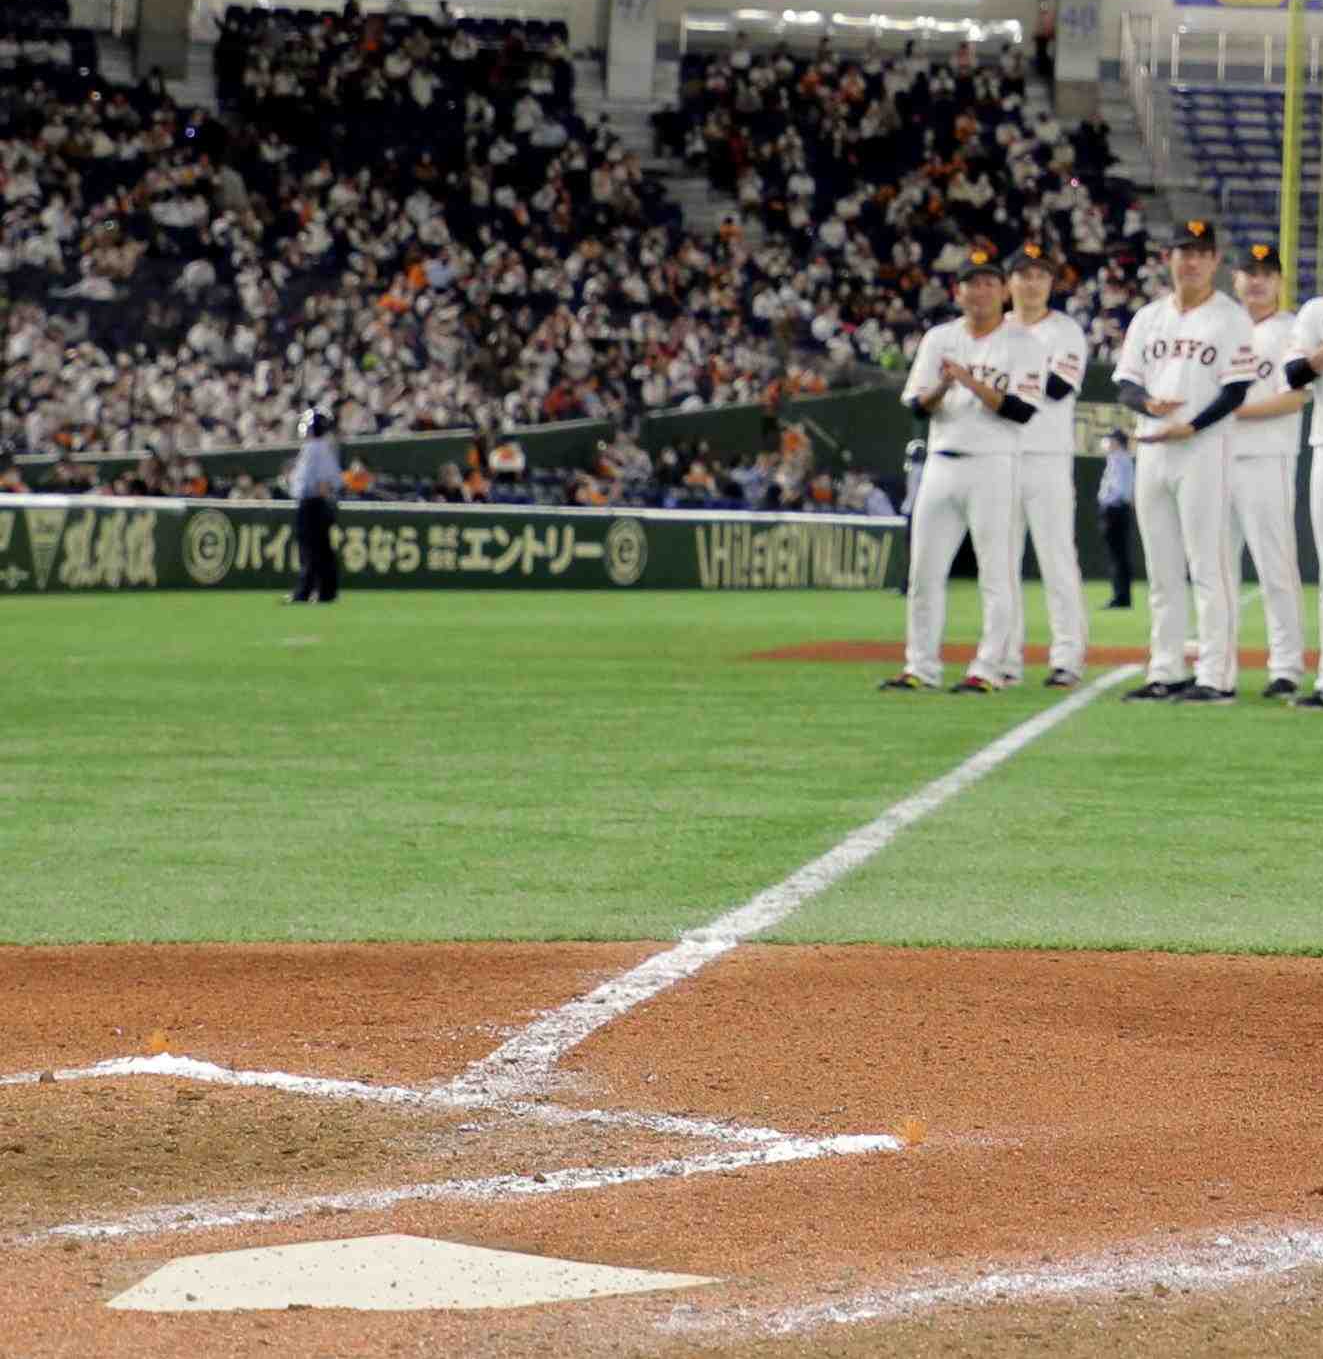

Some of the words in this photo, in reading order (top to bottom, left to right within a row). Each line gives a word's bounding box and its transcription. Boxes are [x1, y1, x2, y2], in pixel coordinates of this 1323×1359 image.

[459, 524, 604, 574] エントリー
